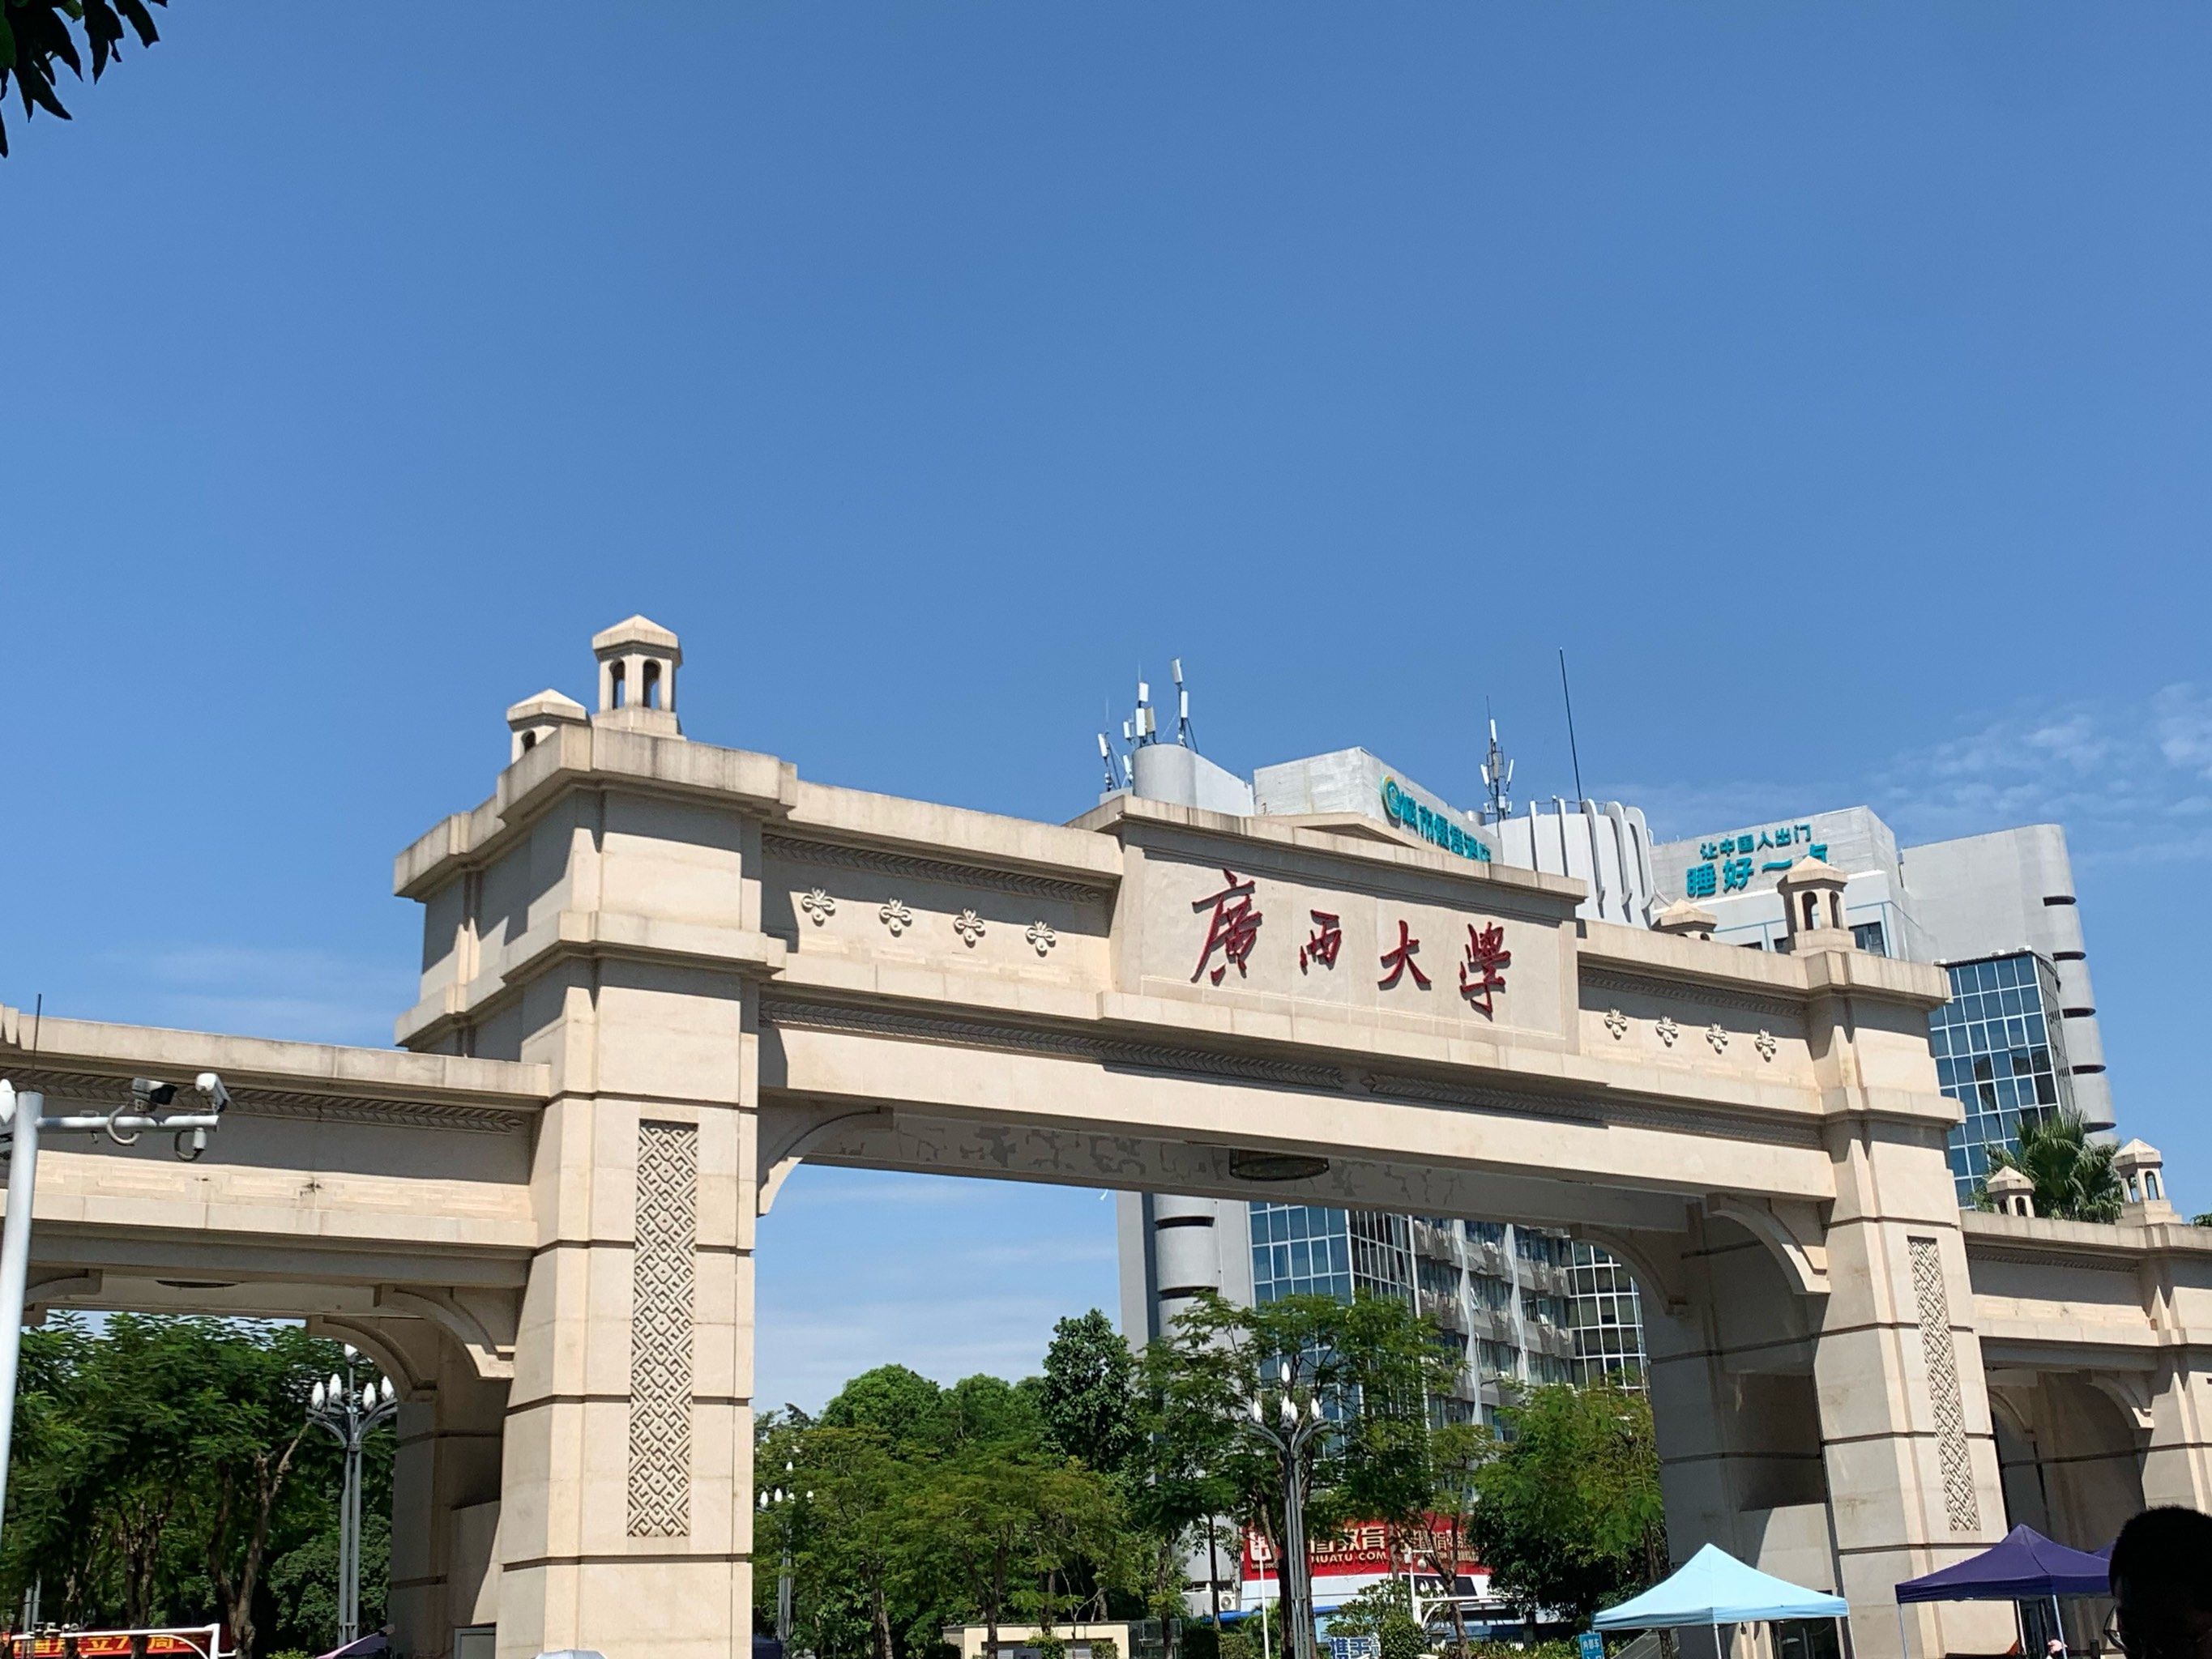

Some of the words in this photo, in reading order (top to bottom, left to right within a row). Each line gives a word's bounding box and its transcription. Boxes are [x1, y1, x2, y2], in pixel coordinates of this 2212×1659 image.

[1700, 823, 1812, 859] 让中国人出门
